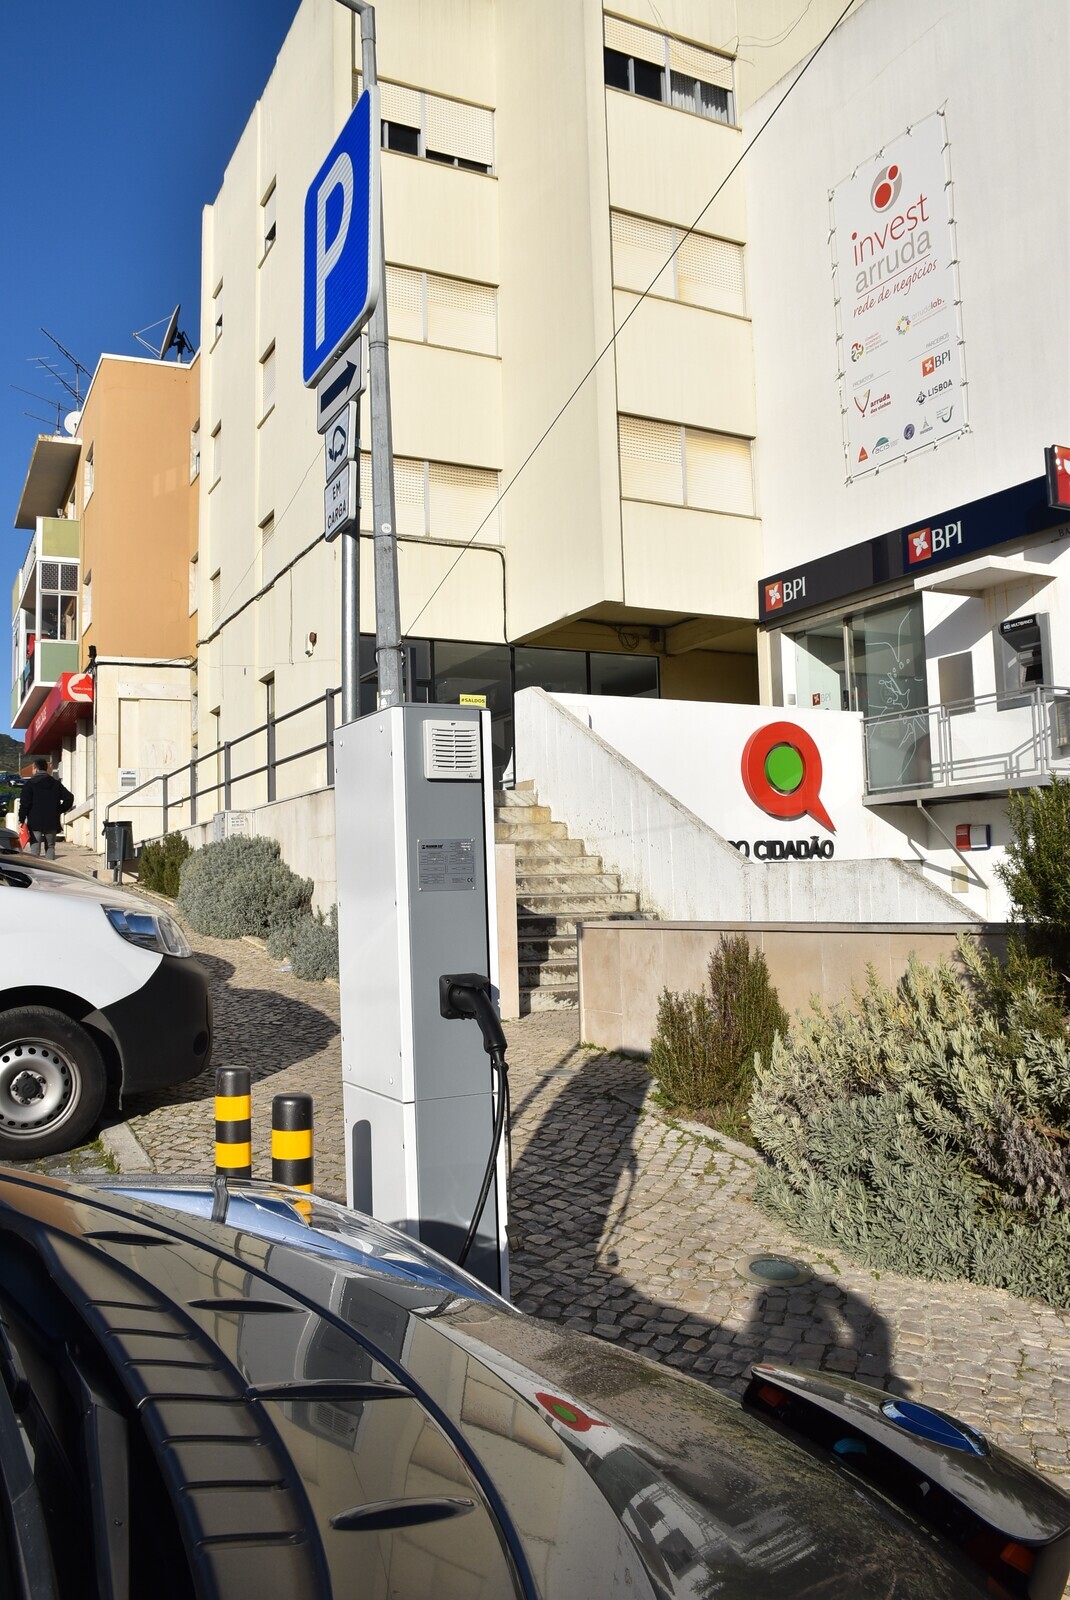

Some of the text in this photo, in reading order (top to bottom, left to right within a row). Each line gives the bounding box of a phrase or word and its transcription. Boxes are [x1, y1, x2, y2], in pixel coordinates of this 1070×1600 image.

[851, 193, 930, 266] invest
[315, 151, 354, 350] P
[855, 230, 932, 293] arruda
[853, 259, 938, 318] rede de negócios
[934, 349, 951, 368] BPI
[870, 393, 891, 408] arruda
[927, 378, 953, 397] LISBOA
[332, 480, 341, 501] EM
[328, 499, 347, 529] CARGA
[931, 520, 963, 553] BPI
[782, 576, 807, 604] BPI
[727, 835, 835, 861] O CIDADÃO
